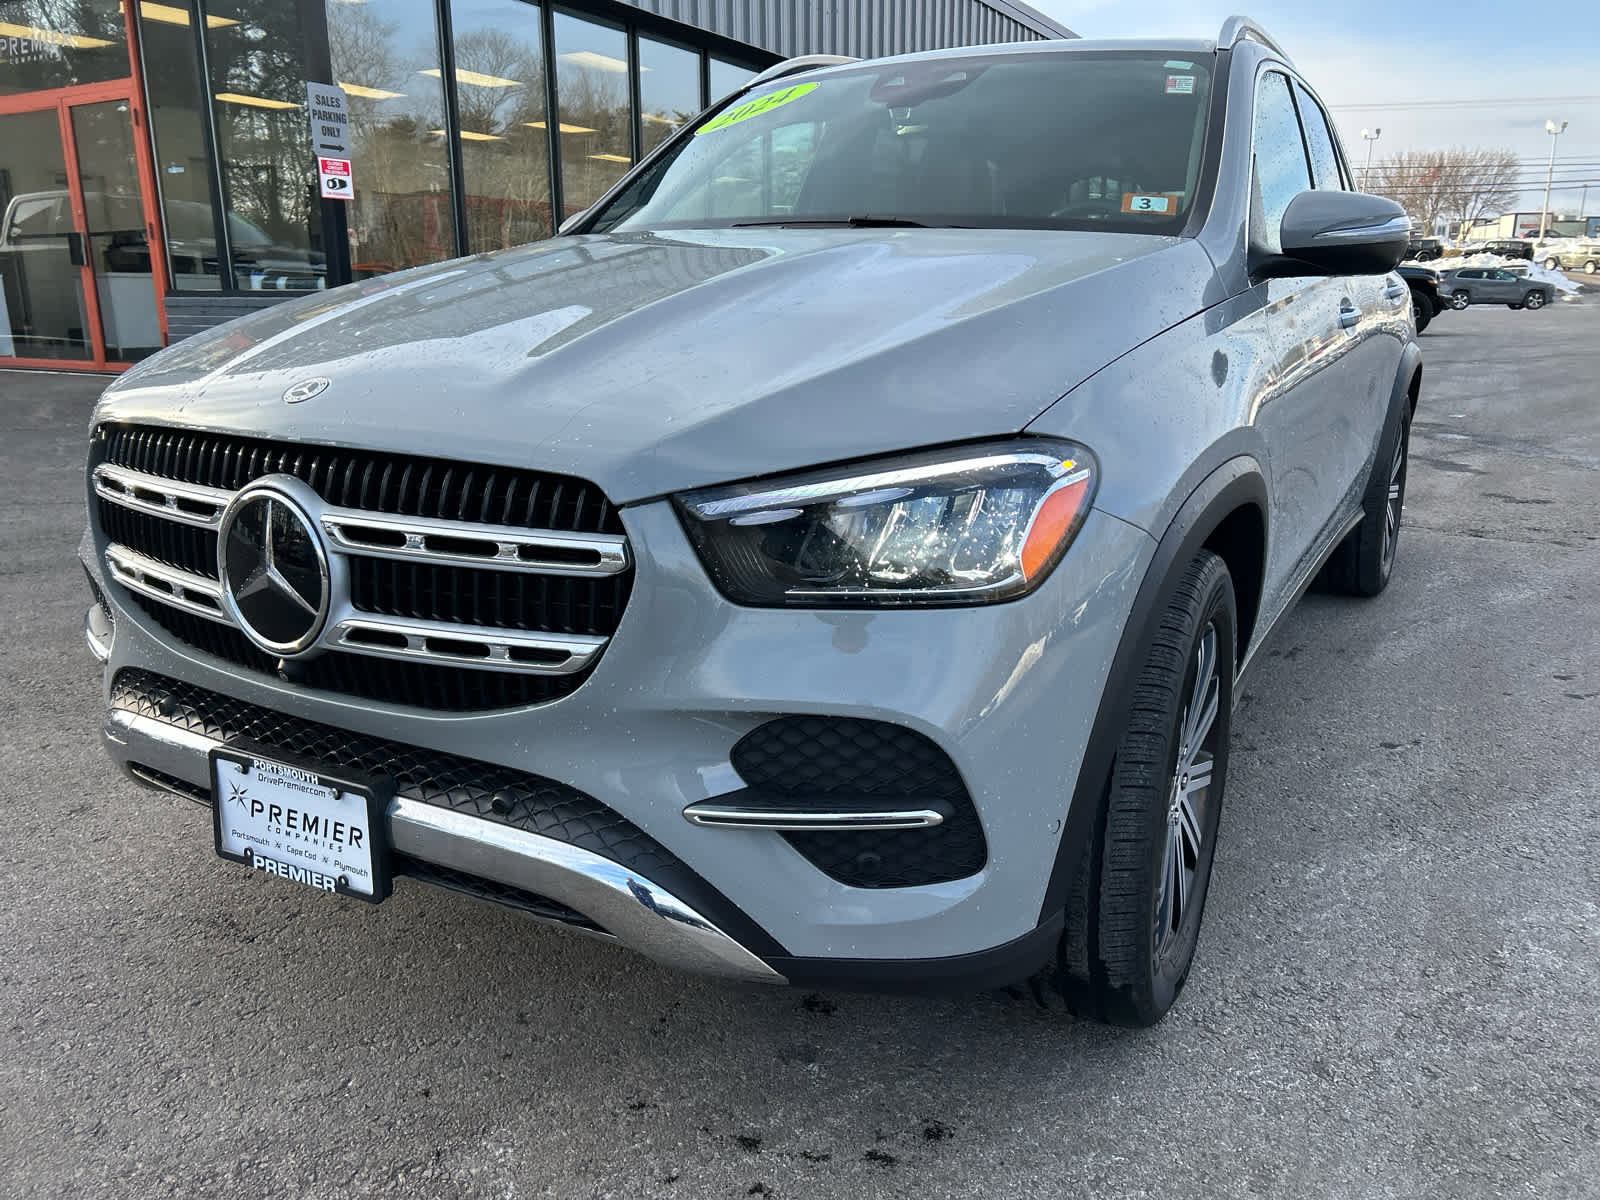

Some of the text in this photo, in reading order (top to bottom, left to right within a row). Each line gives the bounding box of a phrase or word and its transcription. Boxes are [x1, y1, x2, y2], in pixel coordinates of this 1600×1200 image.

[315, 95, 340, 108] SALES
[312, 109, 346, 124] PARKING
[322, 126, 341, 137] ONLY
[1139, 198, 1151, 210] 3
[253, 760, 319, 785] PORTSMOUTH
[257, 773, 326, 798] DrivePremier.com
[251, 799, 363, 849] PREMIER
[267, 825, 343, 853] COMPANIES
[231, 829, 270, 847] Portsmouth
[286, 845, 303, 858] Cape
[334, 860, 368, 877] Plymouth
[253, 855, 336, 892] PREMIER
